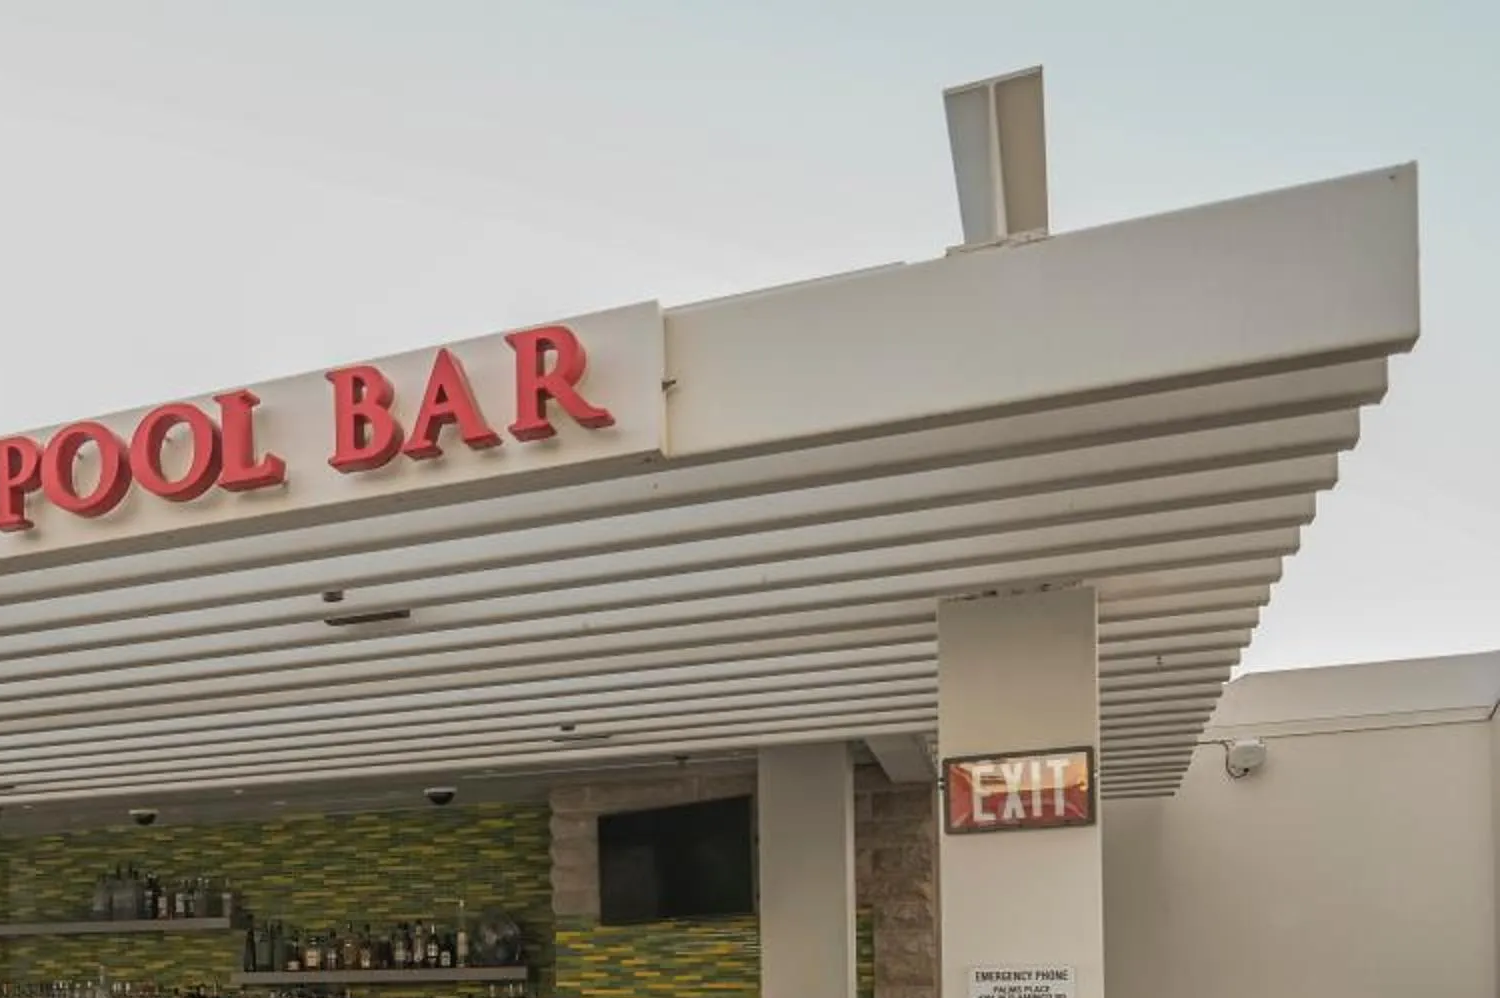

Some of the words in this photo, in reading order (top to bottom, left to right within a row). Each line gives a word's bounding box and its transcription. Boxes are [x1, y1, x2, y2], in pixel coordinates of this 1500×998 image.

[326, 324, 615, 473] BAR
[972, 758, 1070, 822] EXIT
[975, 971, 1032, 981] EMERGENCY
[1035, 969, 1068, 981] PHONE
